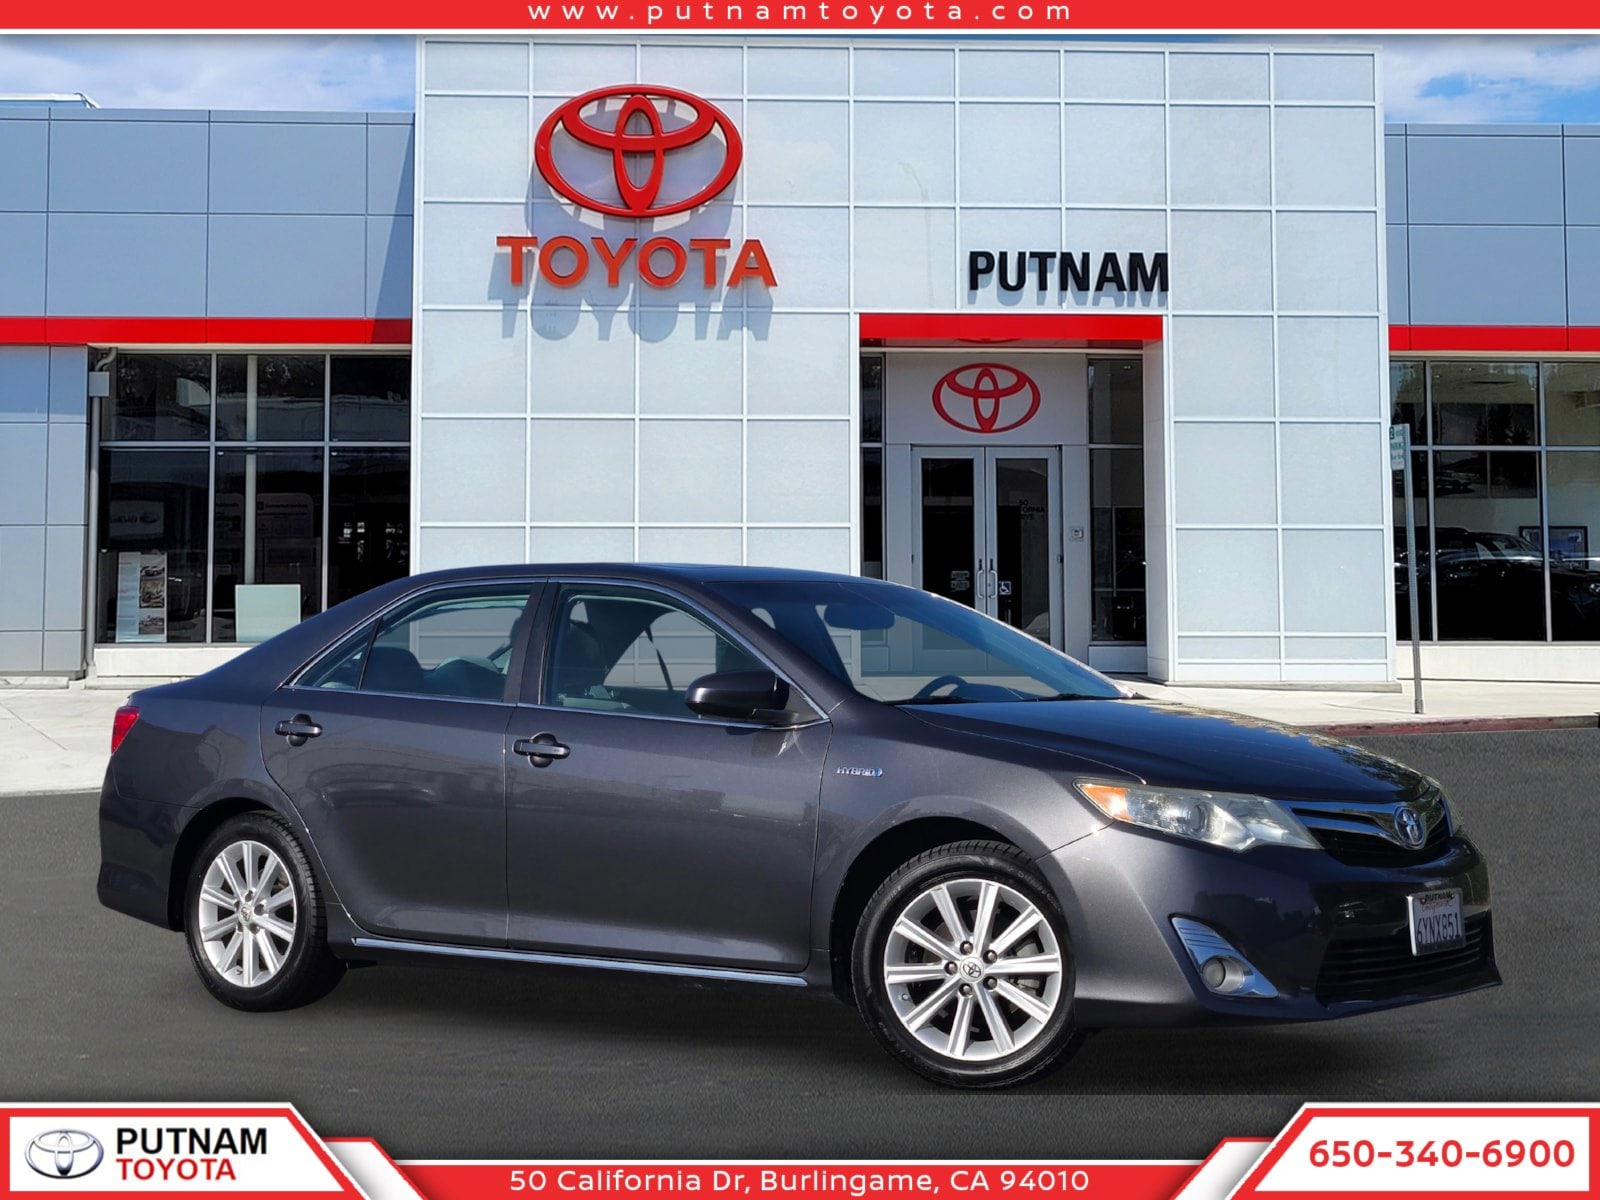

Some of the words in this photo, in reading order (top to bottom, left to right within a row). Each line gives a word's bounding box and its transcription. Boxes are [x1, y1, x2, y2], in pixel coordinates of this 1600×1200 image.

[497, 236, 777, 288] TOYOTA
[969, 251, 1168, 292] PUTNAM
[836, 766, 876, 776] HYBRID
[1417, 912, 1461, 944] 6YNX851
